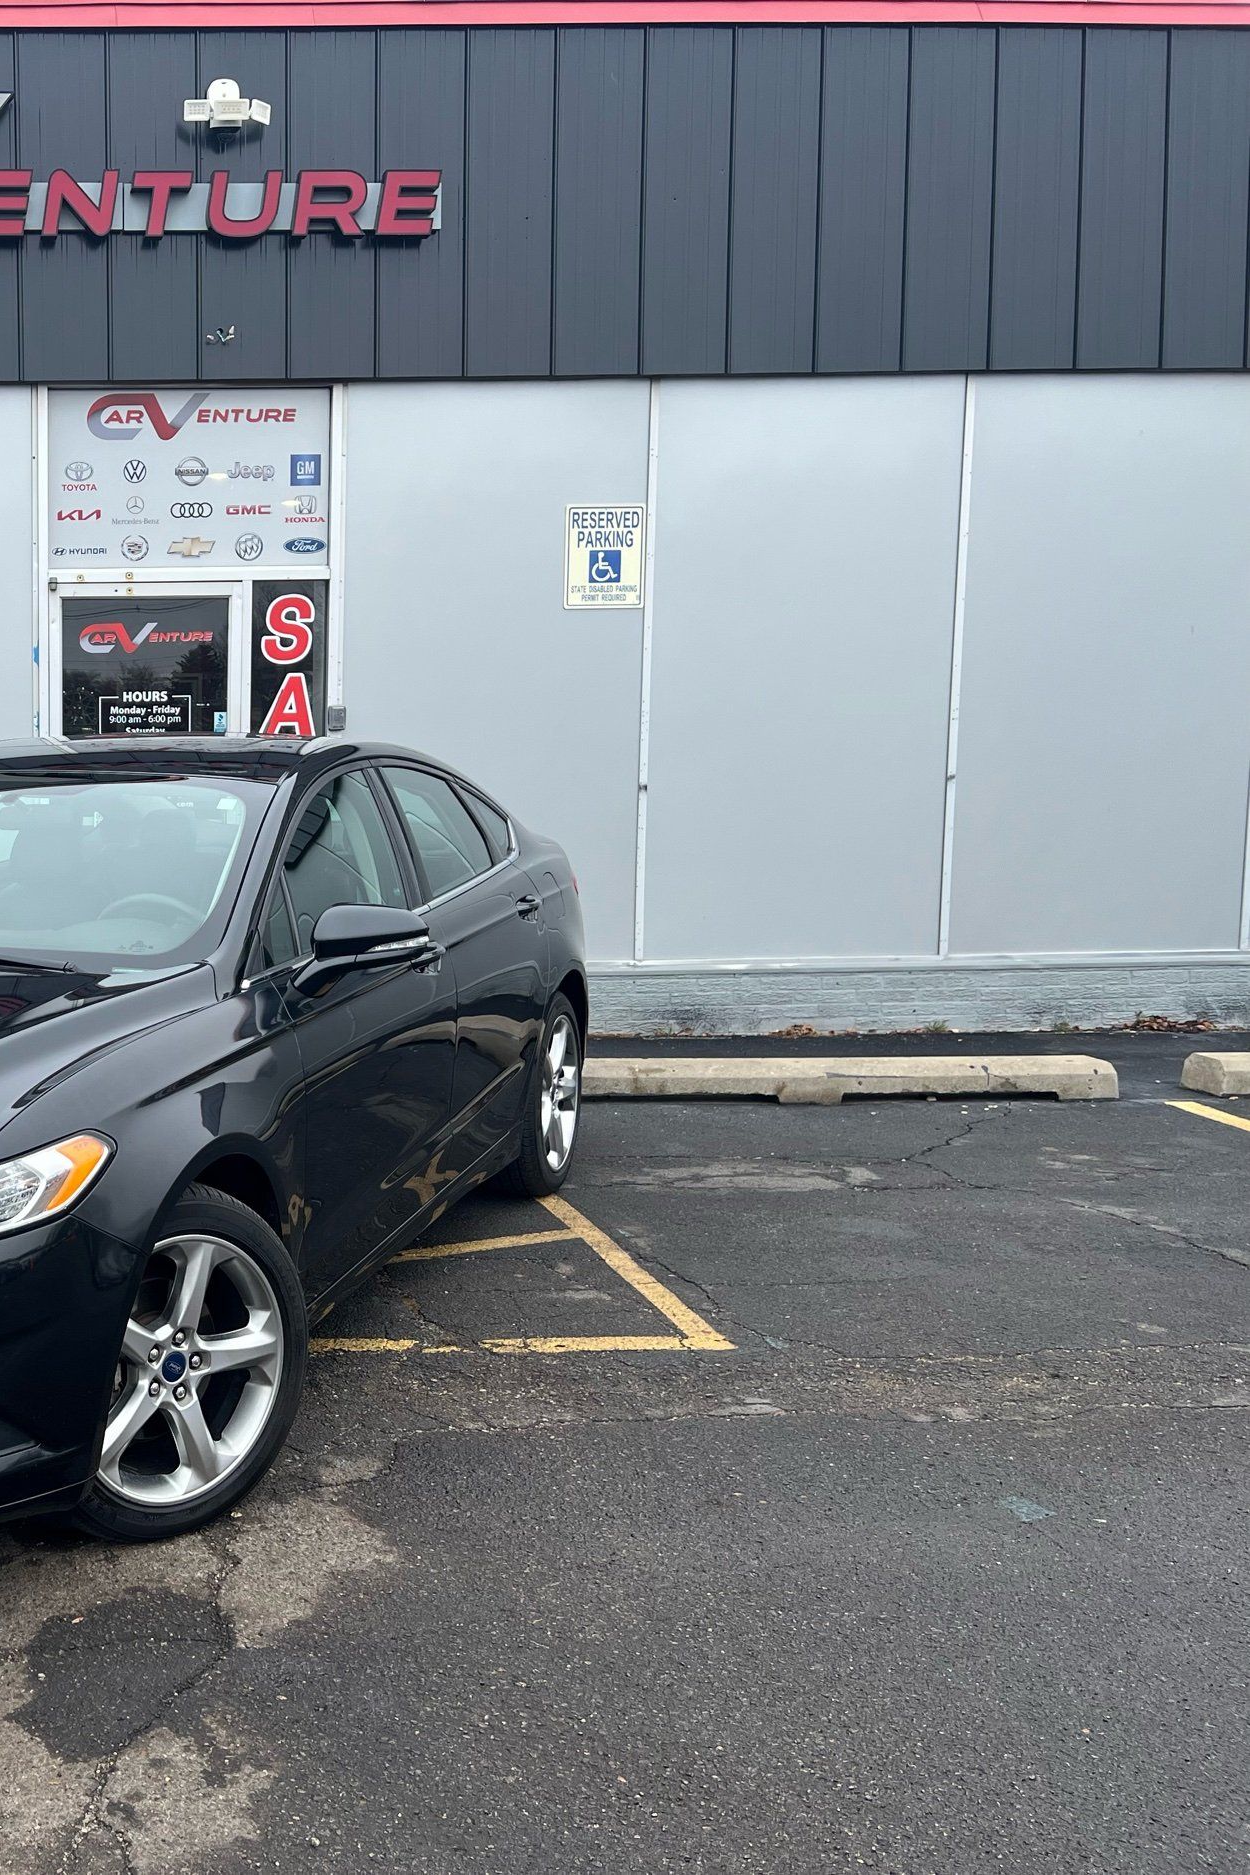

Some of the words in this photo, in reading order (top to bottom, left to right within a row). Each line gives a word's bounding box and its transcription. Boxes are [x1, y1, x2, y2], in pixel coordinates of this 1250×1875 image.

[227, 461, 275, 481] Jeep
[296, 460, 315, 475] GM
[61, 484, 98, 492] TOYOTA
[225, 504, 272, 515] GMC
[572, 511, 640, 529] RESERVED
[577, 530, 634, 548] PARKING
[68, 547, 108, 555] HYUNDAI
[291, 540, 319, 552] Ford
[570, 585, 587, 593] STATE
[589, 585, 614, 593] DISABLED
[616, 584, 638, 593] PARKING
[602, 593, 627, 602] REQUIRED
[122, 690, 169, 702] HOURS
[110, 706, 147, 716] Monday
[152, 705, 181, 715] Friday
[108, 715, 127, 724] 9:00
[127, 716, 142, 724] am
[147, 715, 166, 723] 6:00
[166, 716, 182, 725] pm
